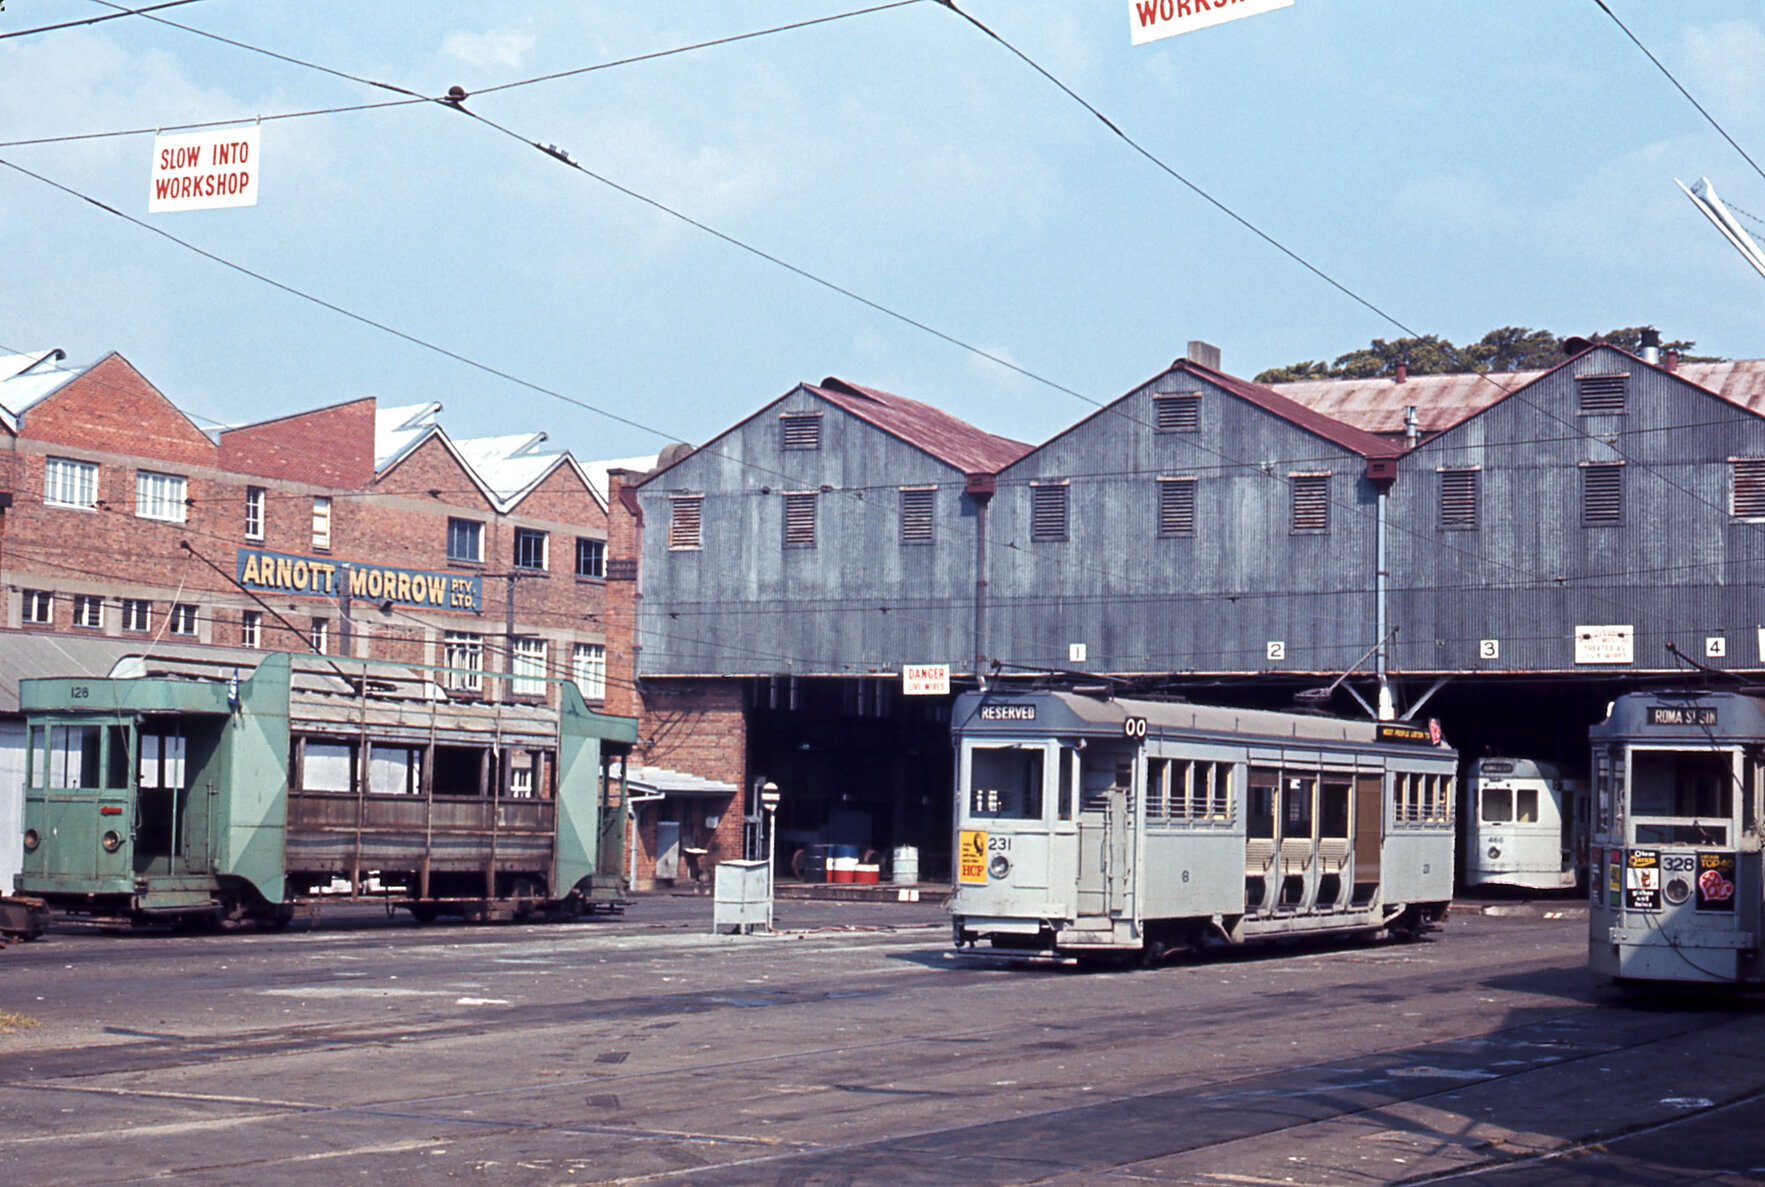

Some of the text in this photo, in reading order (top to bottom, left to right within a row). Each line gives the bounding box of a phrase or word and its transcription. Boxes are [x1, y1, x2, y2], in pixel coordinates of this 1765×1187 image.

[160, 141, 249, 170] SLOW INTO
[156, 171, 249, 200] WORKSHOP
[242, 554, 446, 605] ARNOTT MORROW
[1270, 643, 1282, 657] 2
[1484, 641, 1496, 656] 3
[1709, 640, 1722, 653] 4
[908, 667, 945, 680] DANGER
[71, 687, 89, 698] 128
[981, 706, 1036, 720] RESERVED
[1655, 709, 1683, 724] ROMA
[1126, 718, 1147, 736] 00
[989, 837, 1012, 851] 231
[1663, 857, 1695, 872] 328
